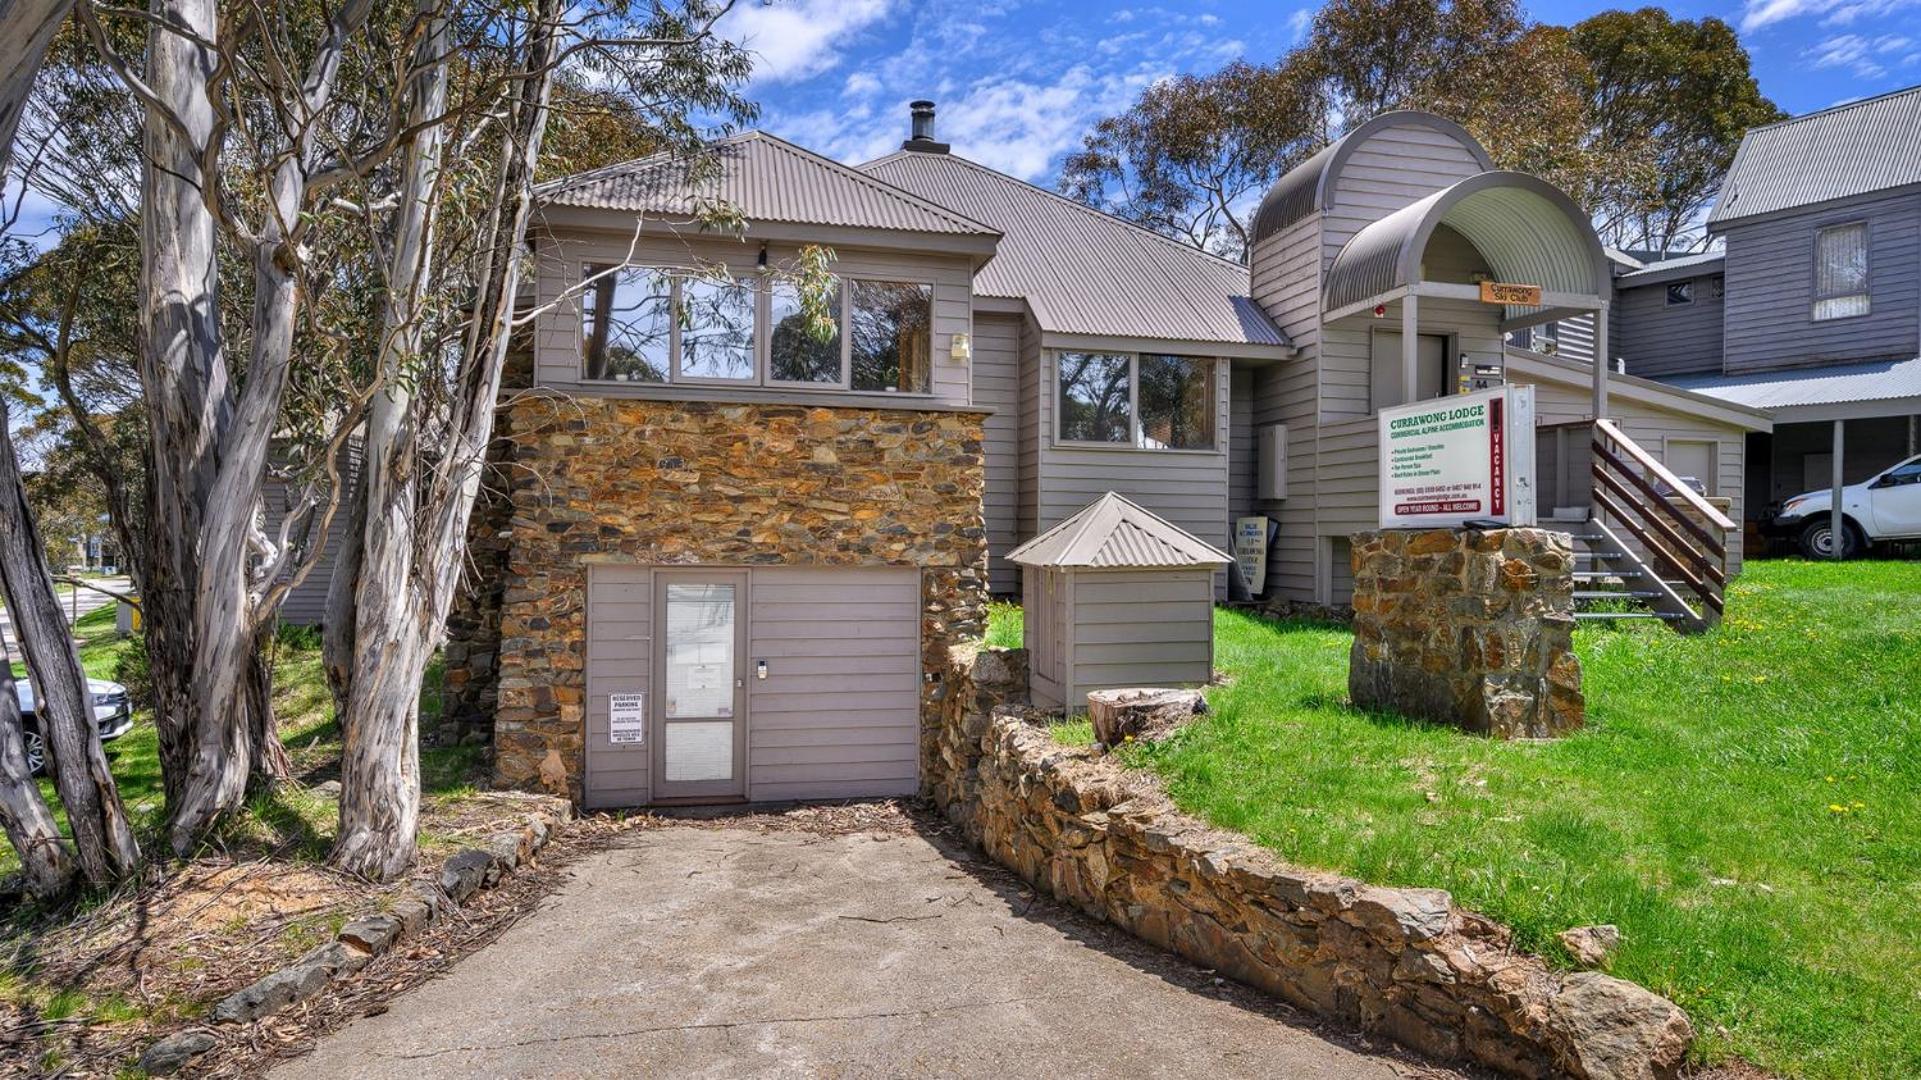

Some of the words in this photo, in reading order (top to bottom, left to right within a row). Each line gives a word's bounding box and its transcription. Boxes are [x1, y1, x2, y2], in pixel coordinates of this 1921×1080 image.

[1494, 291, 1507, 301] Ski
[1510, 293, 1529, 302] Club
[1390, 412, 1447, 429] CURRAWONG
[1449, 405, 1484, 420] LODGE
[1421, 425, 1439, 435] ALPINE
[1439, 419, 1485, 431] ACCOMMODATION
[1396, 505, 1410, 514] OPEN
